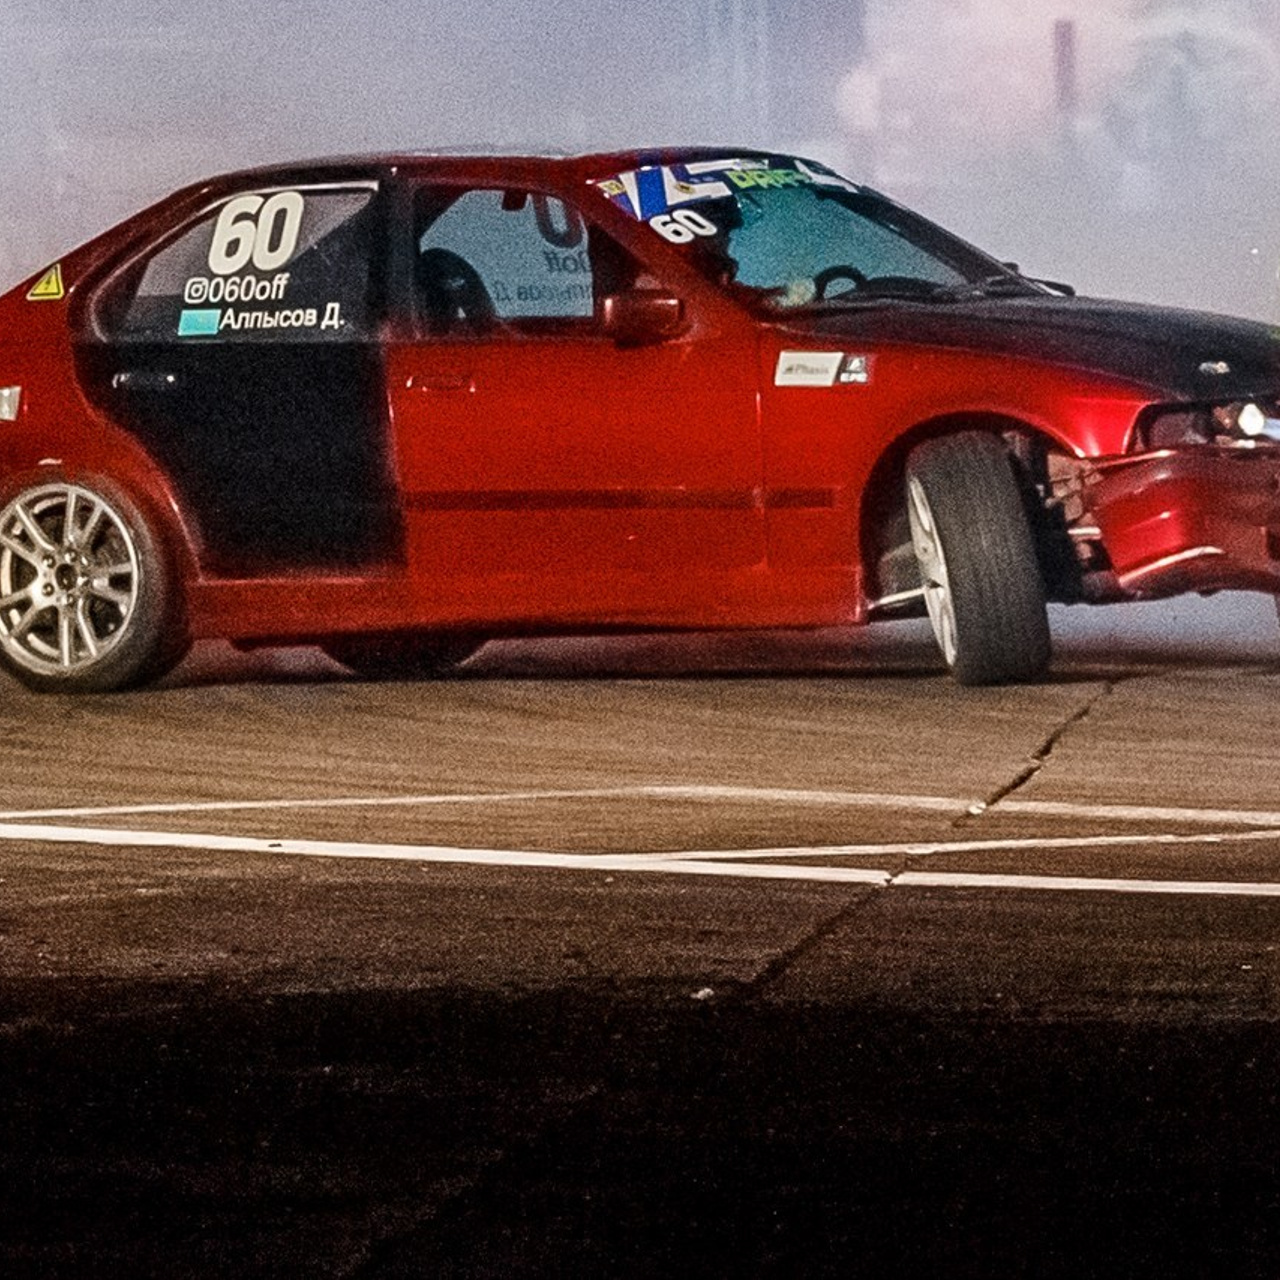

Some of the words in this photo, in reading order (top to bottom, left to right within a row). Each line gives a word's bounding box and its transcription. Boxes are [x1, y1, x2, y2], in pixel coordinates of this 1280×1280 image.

[208, 191, 305, 275] 60
[650, 209, 717, 244] 60
[219, 308, 317, 331] Алпысов
[320, 302, 345, 331] Д.
